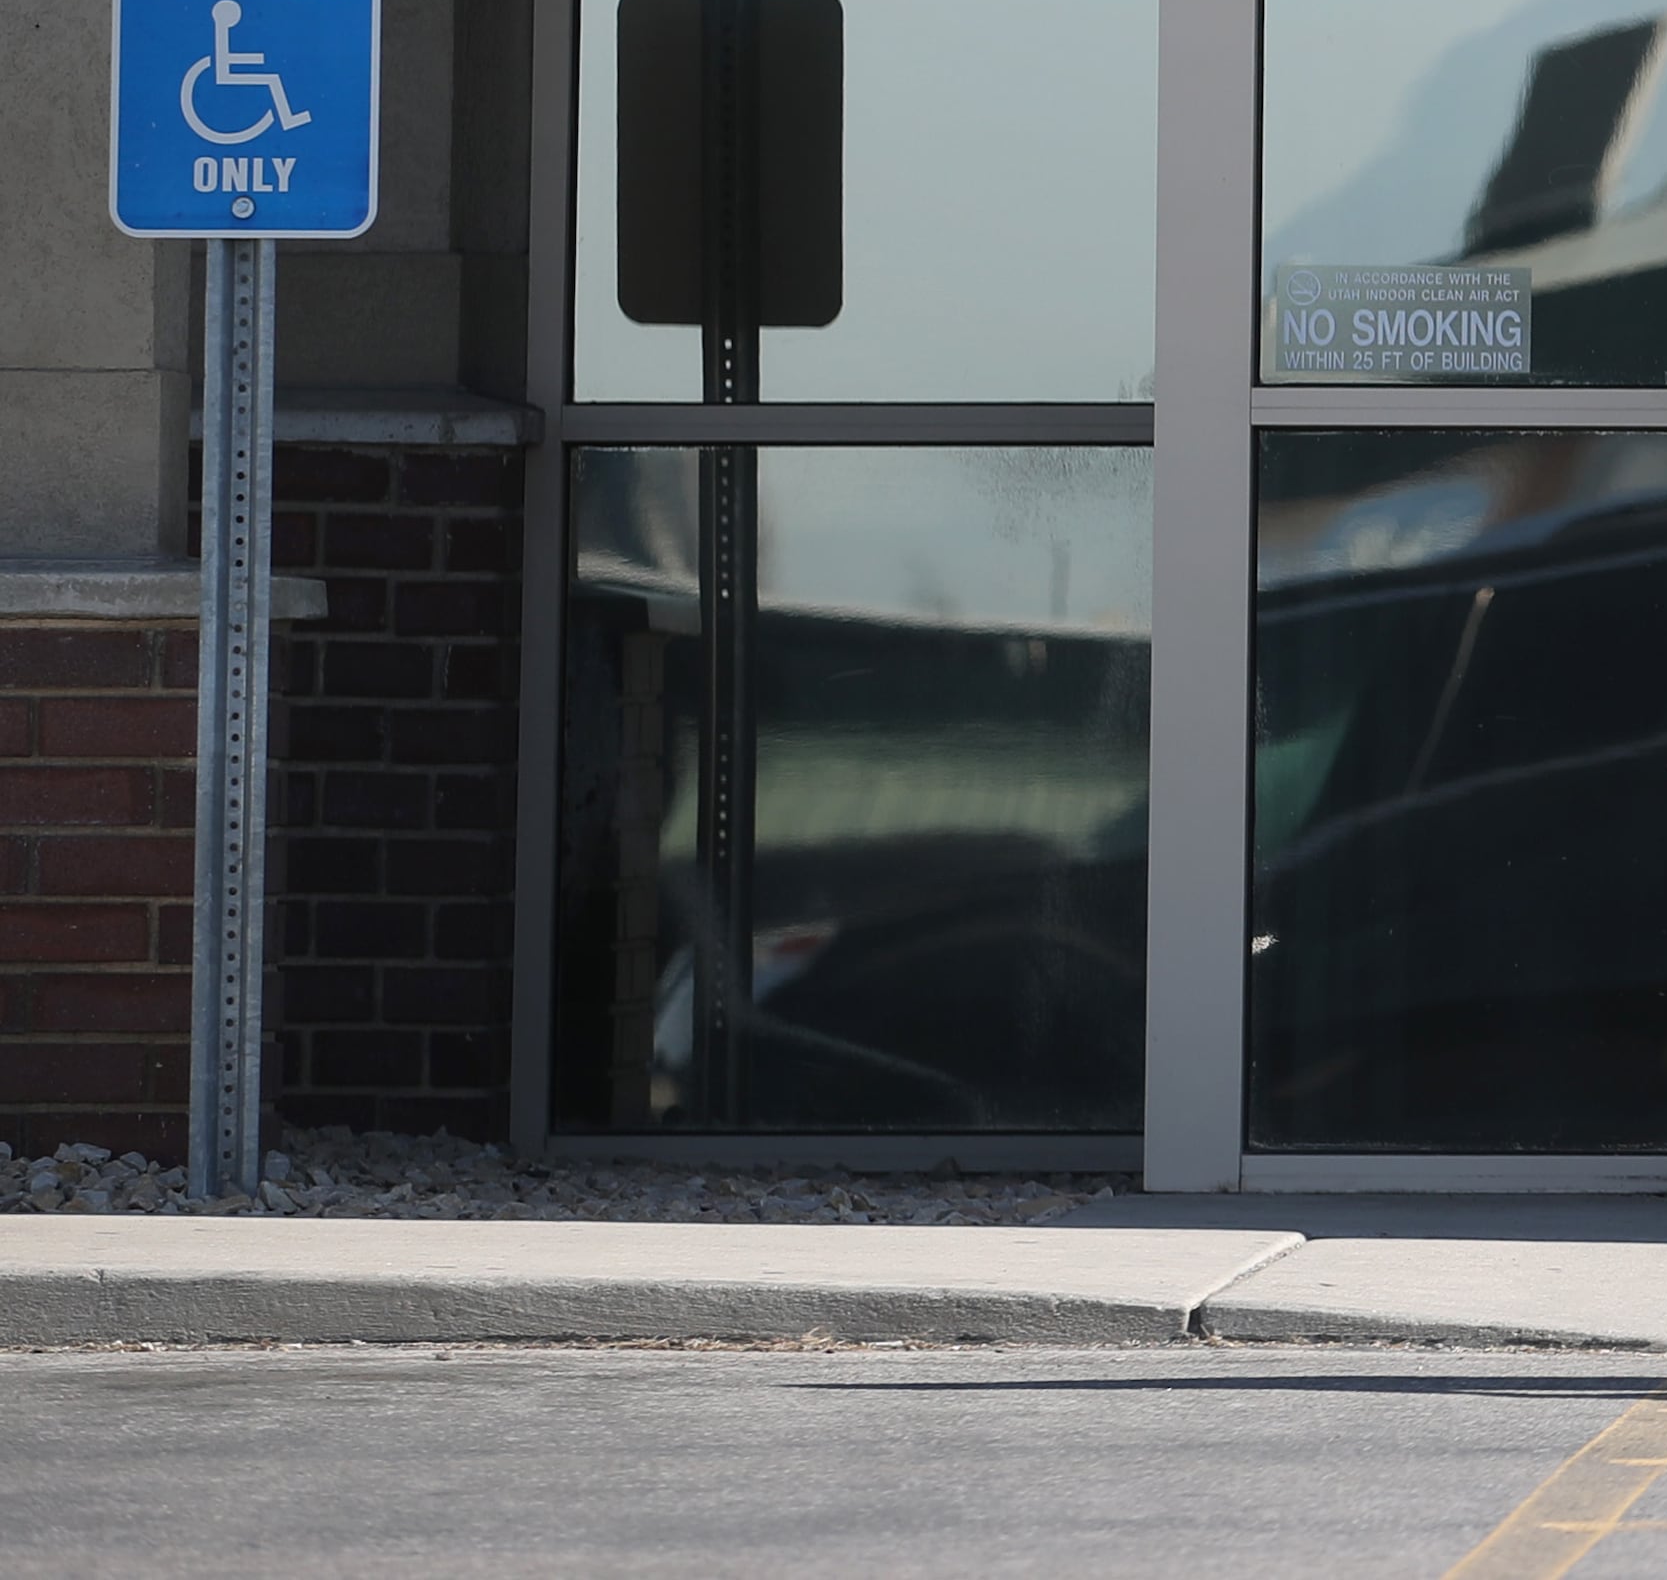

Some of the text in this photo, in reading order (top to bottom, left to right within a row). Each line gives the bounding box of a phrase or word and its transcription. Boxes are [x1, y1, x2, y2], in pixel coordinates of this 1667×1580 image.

[193, 157, 297, 193] ONLY
[1336, 273, 1511, 286] IN ACCORDANCE WITH THE
[1329, 289, 1520, 302] UTAH INDOOR CLEAN AIR ACT
[1283, 309, 1522, 347] NO SMOKING
[1284, 351, 1523, 371] WITHIN 25 FT OF BUILDING
